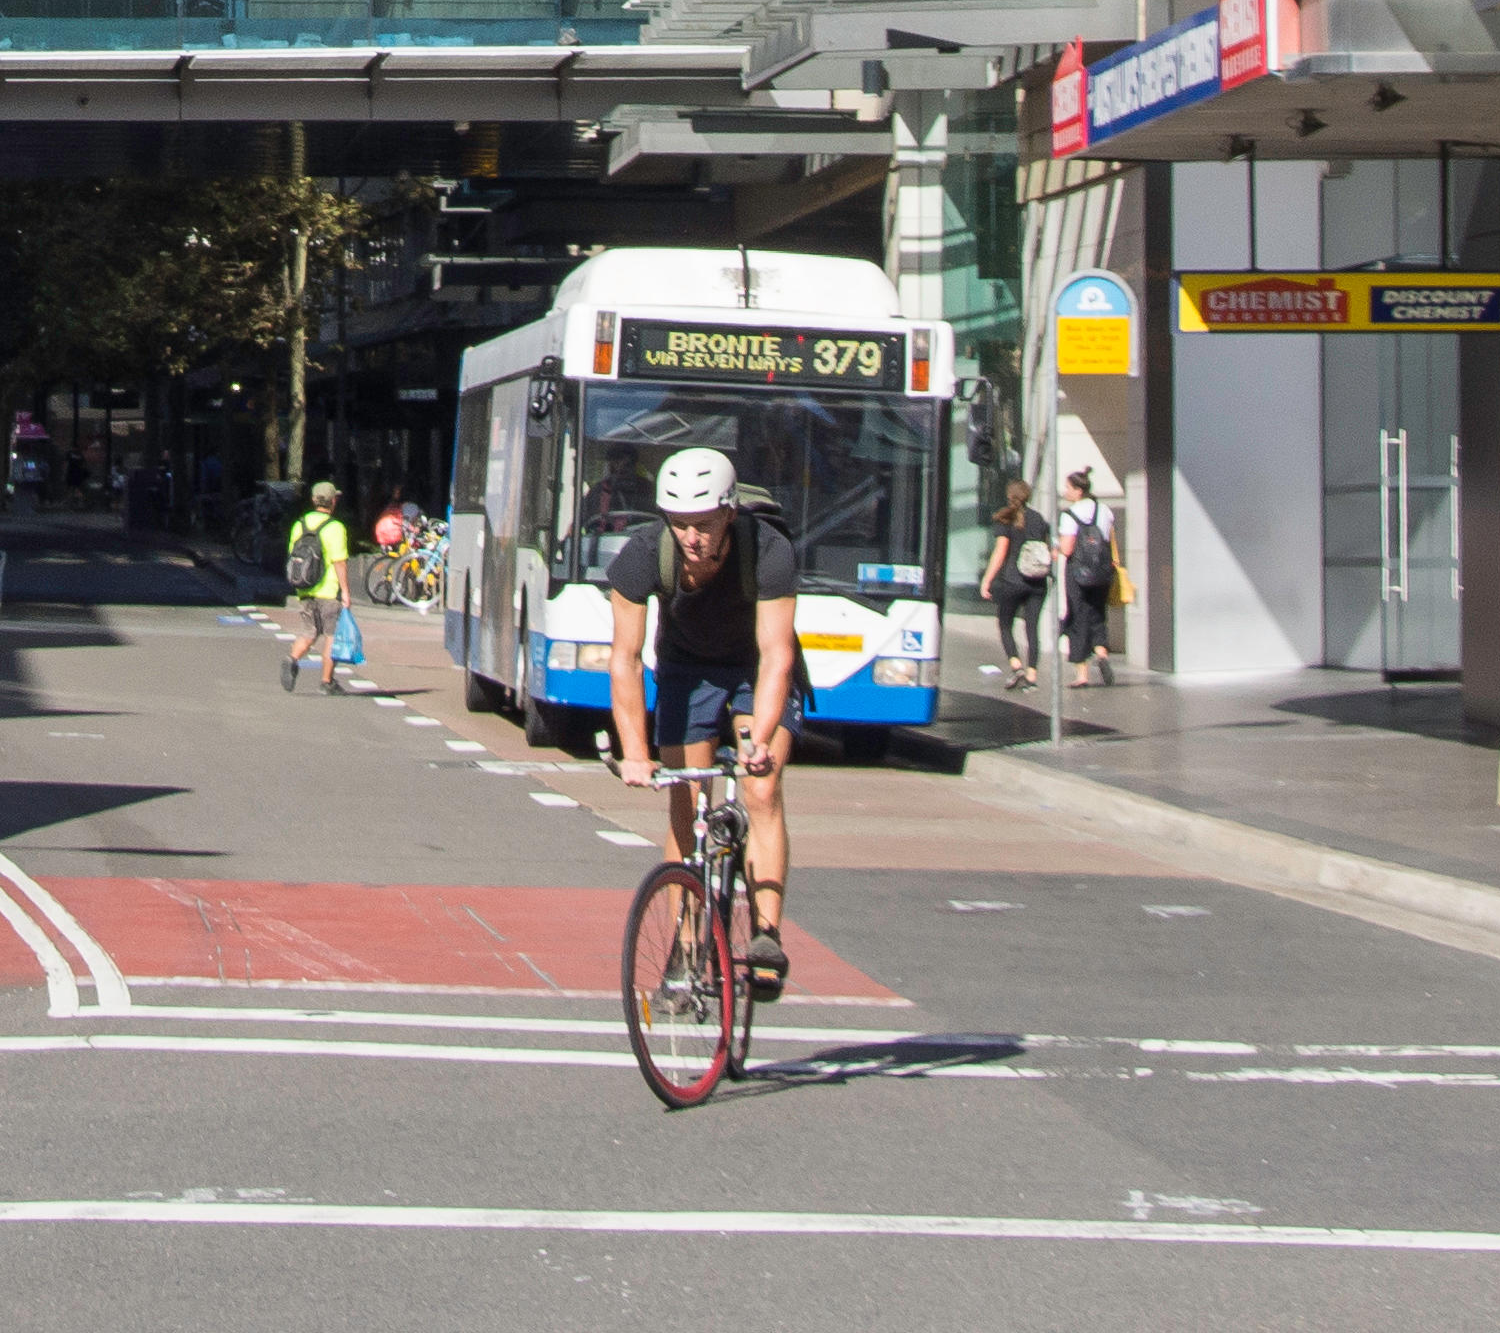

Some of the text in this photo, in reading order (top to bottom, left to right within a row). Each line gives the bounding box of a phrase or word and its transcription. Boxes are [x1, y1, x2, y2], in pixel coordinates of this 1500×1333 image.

[1208, 290, 1343, 310] CHEMIST
[1381, 289, 1494, 304] DISCOUNT
[1391, 305, 1486, 320] CHEMIST
[668, 331, 782, 357] BRONTE
[646, 350, 803, 373] VIA SEVEN WAYS
[812, 338, 882, 377] 379
